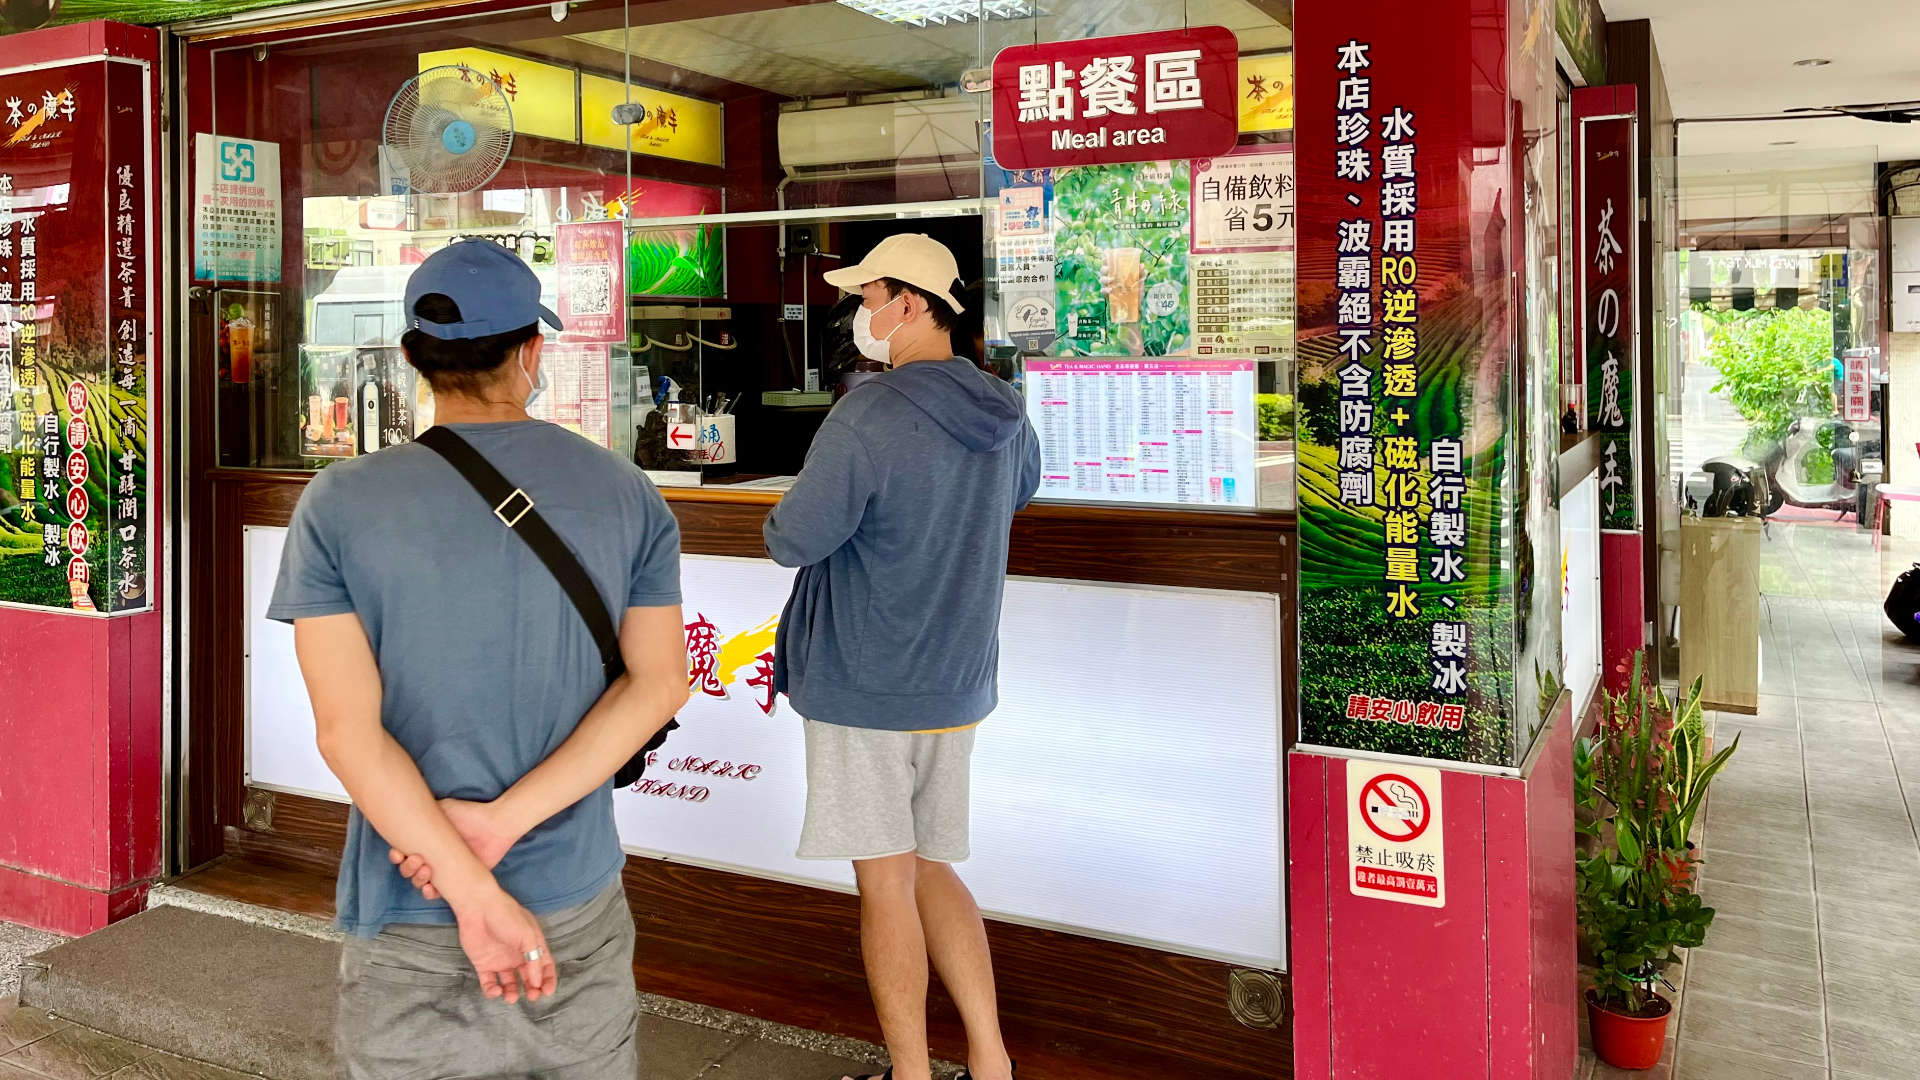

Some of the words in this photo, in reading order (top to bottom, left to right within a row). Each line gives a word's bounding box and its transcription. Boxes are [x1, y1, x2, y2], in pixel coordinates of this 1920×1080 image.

[5, 87, 76, 128] 茶の魔手
[1018, 49, 1204, 123] 點餐區
[1051, 127, 1107, 151] Meal
[1112, 126, 1167, 147] area
[1202, 173, 1295, 203] 自備飲料
[1224, 203, 1295, 233] 省5元
[1337, 40, 1373, 506] 本店珍珠、波霸絕不含防腐劑
[20, 217, 37, 522] 水質採用RO逆滲透+磁化能量水
[1382, 107, 1420, 618] 水質採用RO逆滲透+磁化能量水
[1594, 197, 1624, 516] 茶の魔手
[43, 412, 61, 567] 自行製水、製冰
[69, 383, 88, 582] 敬請安心飲用
[1430, 438, 1467, 695] 自行製水、製冰
[1347, 695, 1465, 732] 請安心飲用
[631, 778, 712, 802] HAND
[1355, 844, 1436, 873] 禁止吸菸
